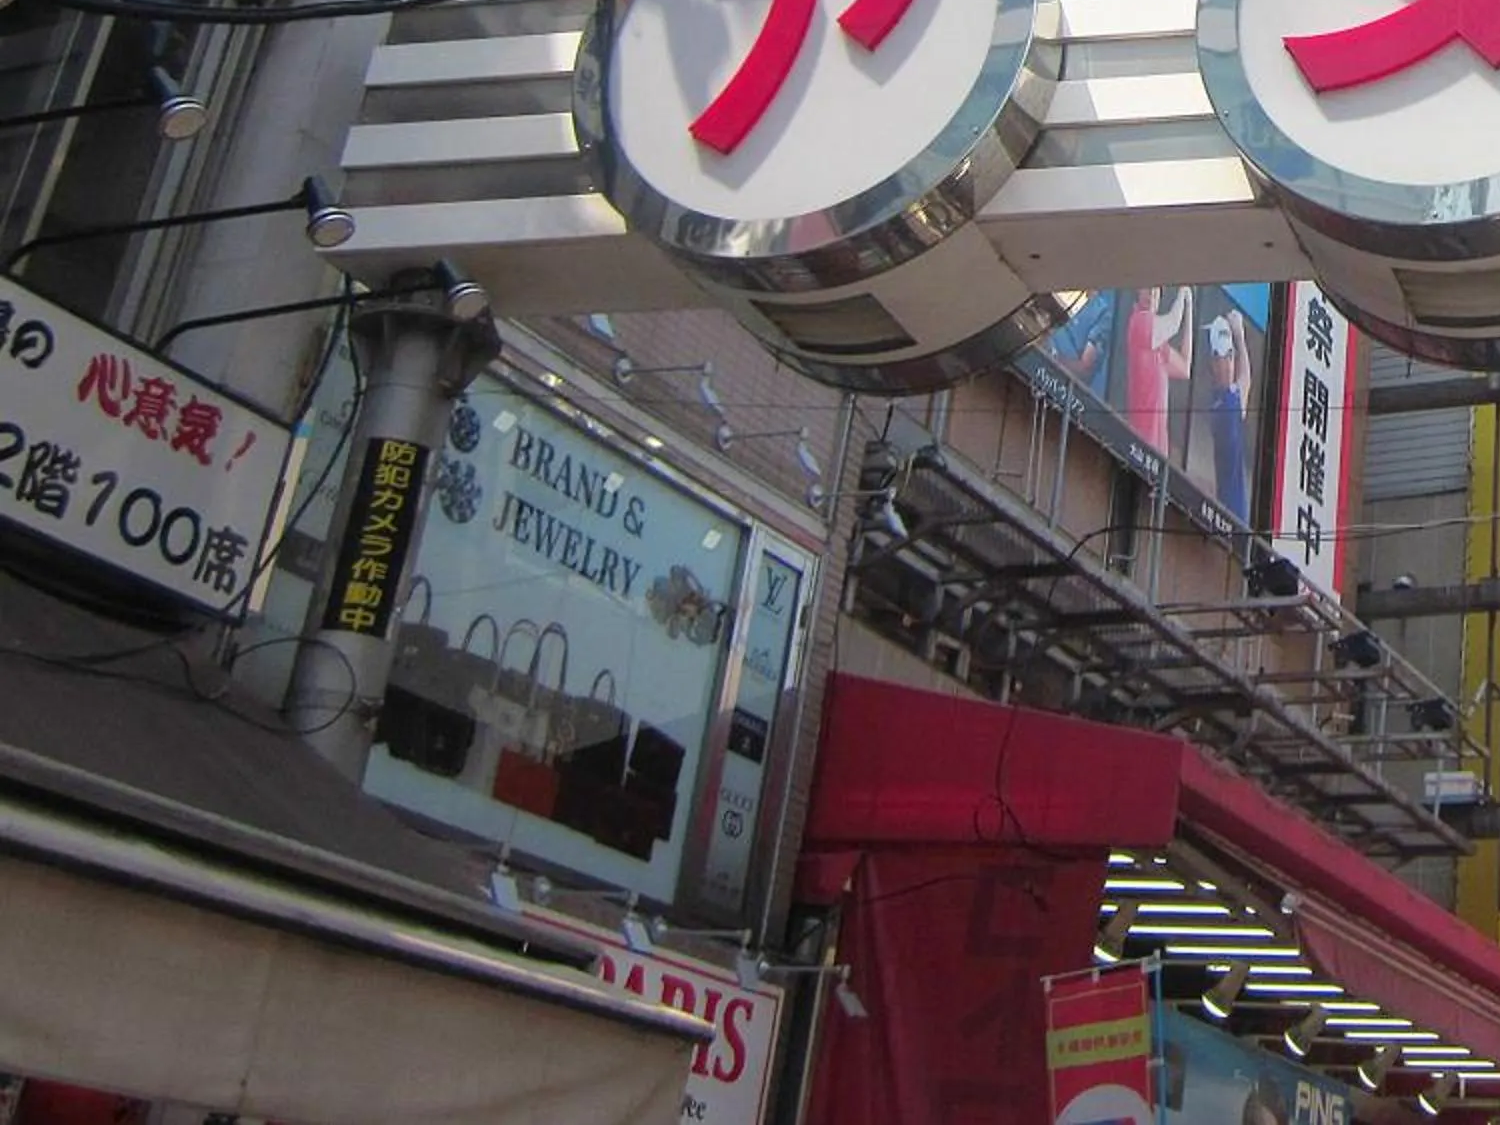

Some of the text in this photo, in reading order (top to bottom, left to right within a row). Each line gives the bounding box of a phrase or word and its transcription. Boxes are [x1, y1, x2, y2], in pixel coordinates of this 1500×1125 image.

[339, 439, 418, 632] 防犯カメラ作動中
[509, 427, 647, 539] BRAND &
[493, 490, 642, 598] JEWELRY
